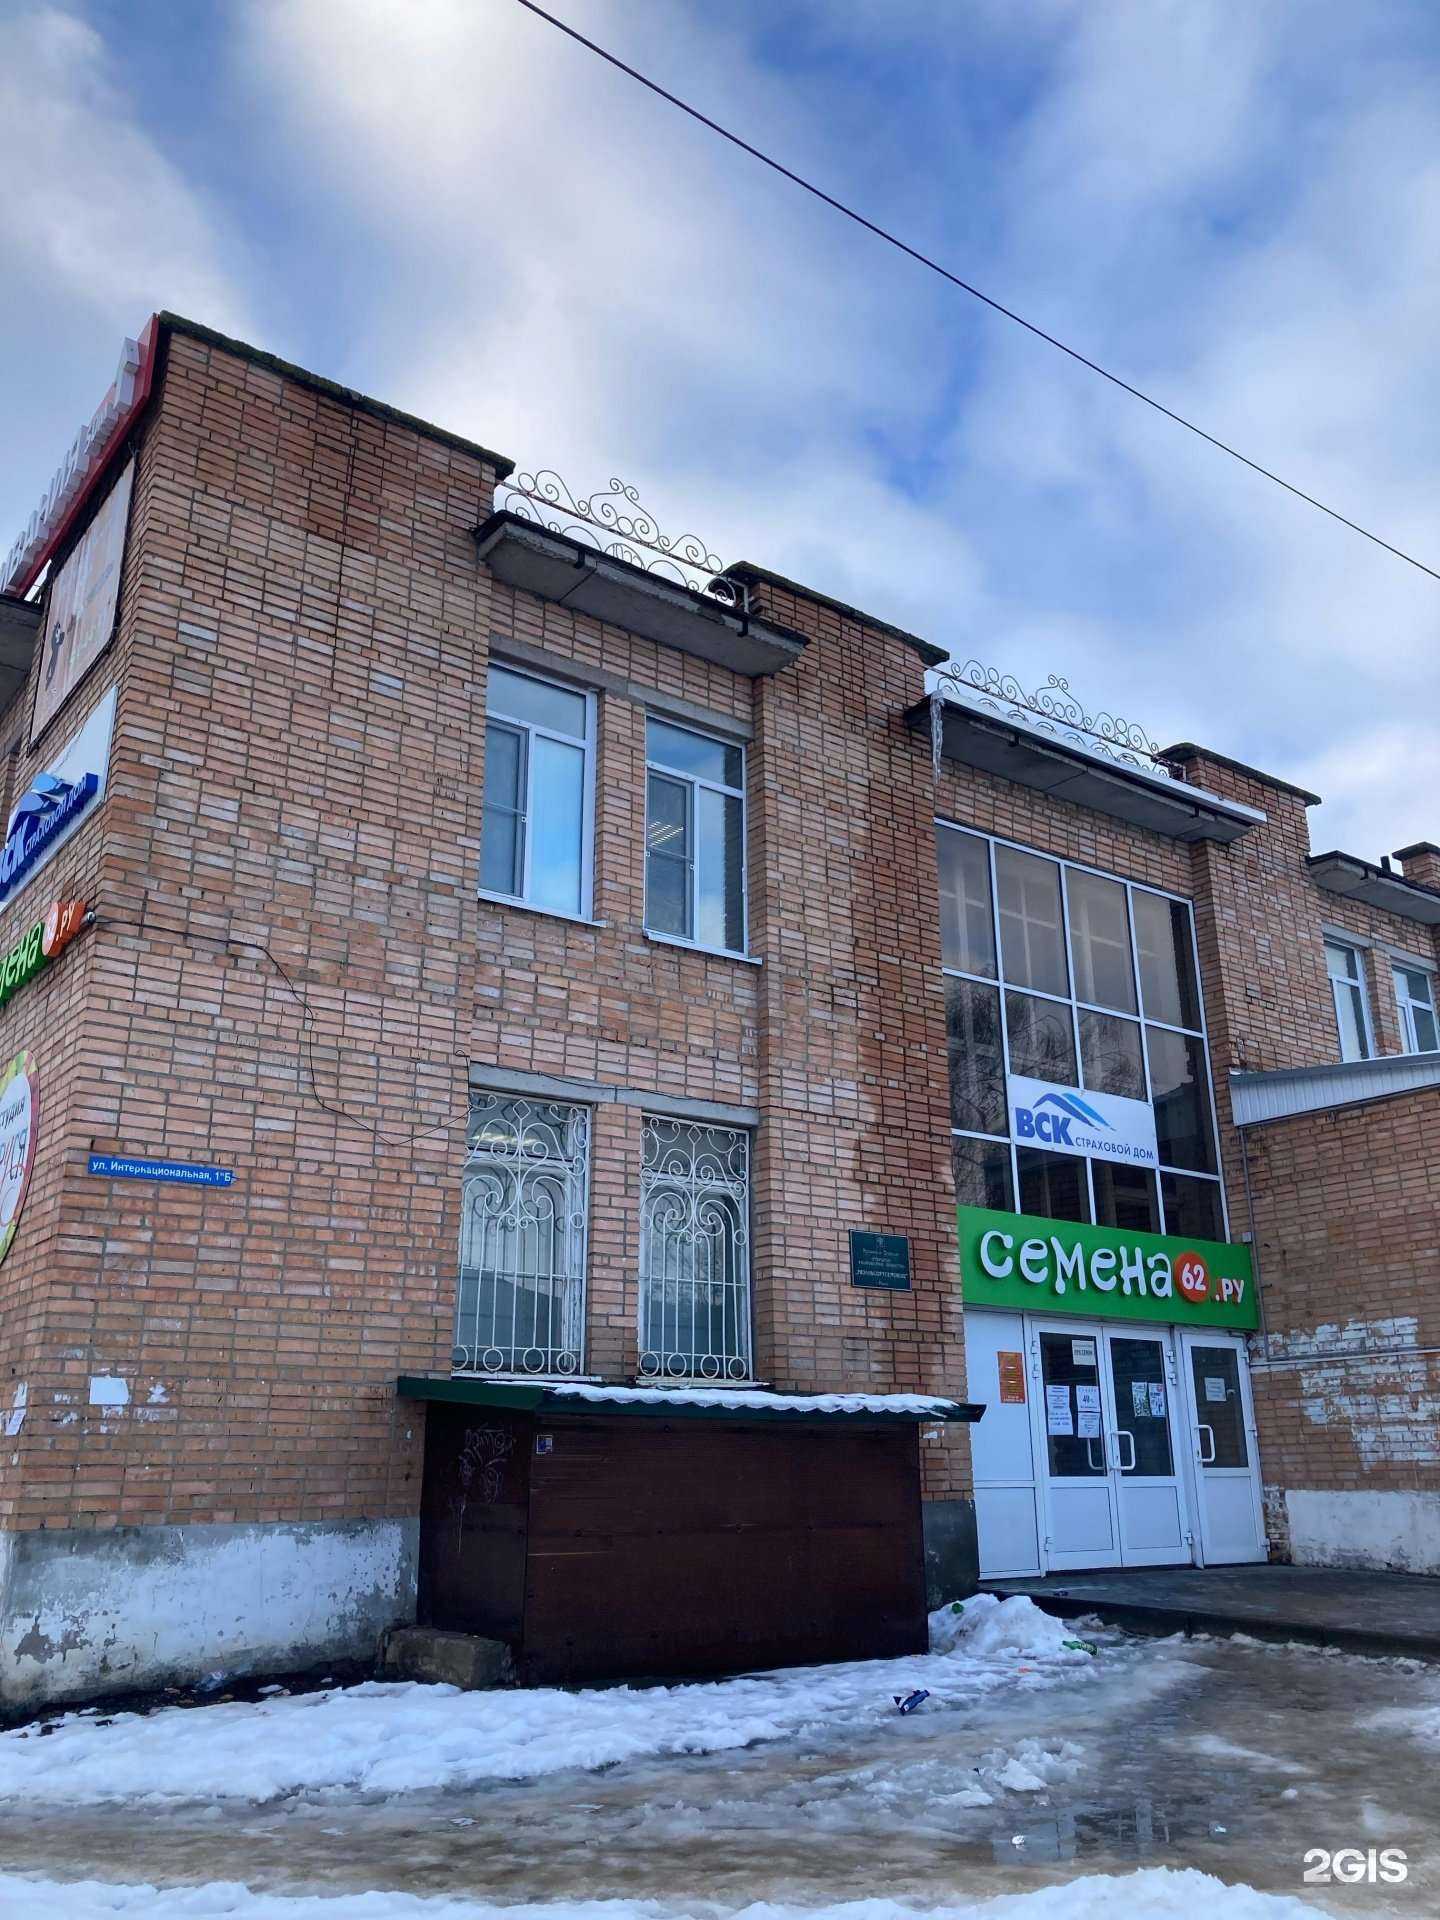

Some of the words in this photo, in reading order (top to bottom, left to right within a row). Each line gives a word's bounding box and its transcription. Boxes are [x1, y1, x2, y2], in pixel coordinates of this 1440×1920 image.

[1014, 1107, 1075, 1147] ВСК
[1075, 1136, 1132, 1156] СТРАХОВОЙ
[1132, 1145, 1155, 1160] ДОМ
[92, 1160, 108, 1172] ул.
[111, 1161, 212, 1182] Интернациональная,
